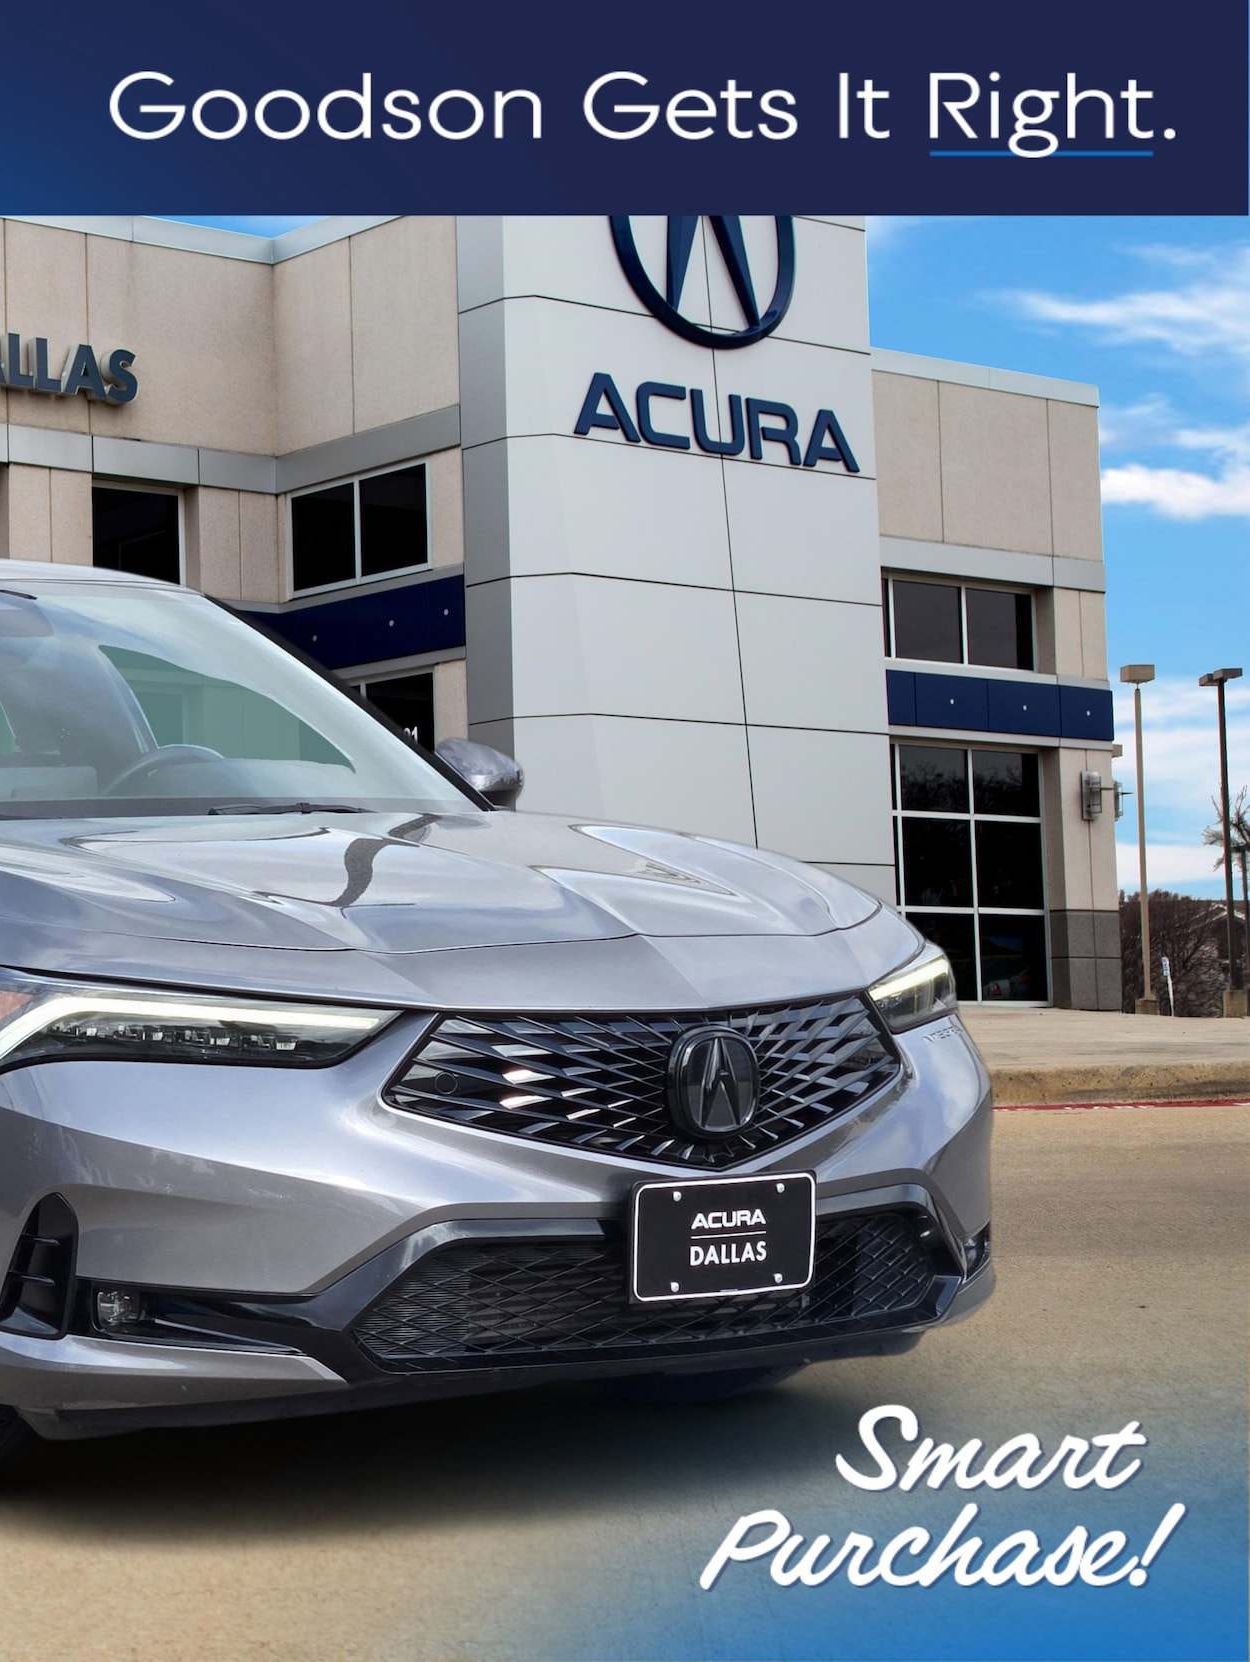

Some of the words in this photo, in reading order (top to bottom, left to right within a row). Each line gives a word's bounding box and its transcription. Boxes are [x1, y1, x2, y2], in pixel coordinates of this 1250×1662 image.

[573, 372, 860, 473] ACURA
[690, 1208, 767, 1230] ACURA
[689, 1240, 767, 1266] DALLAS
